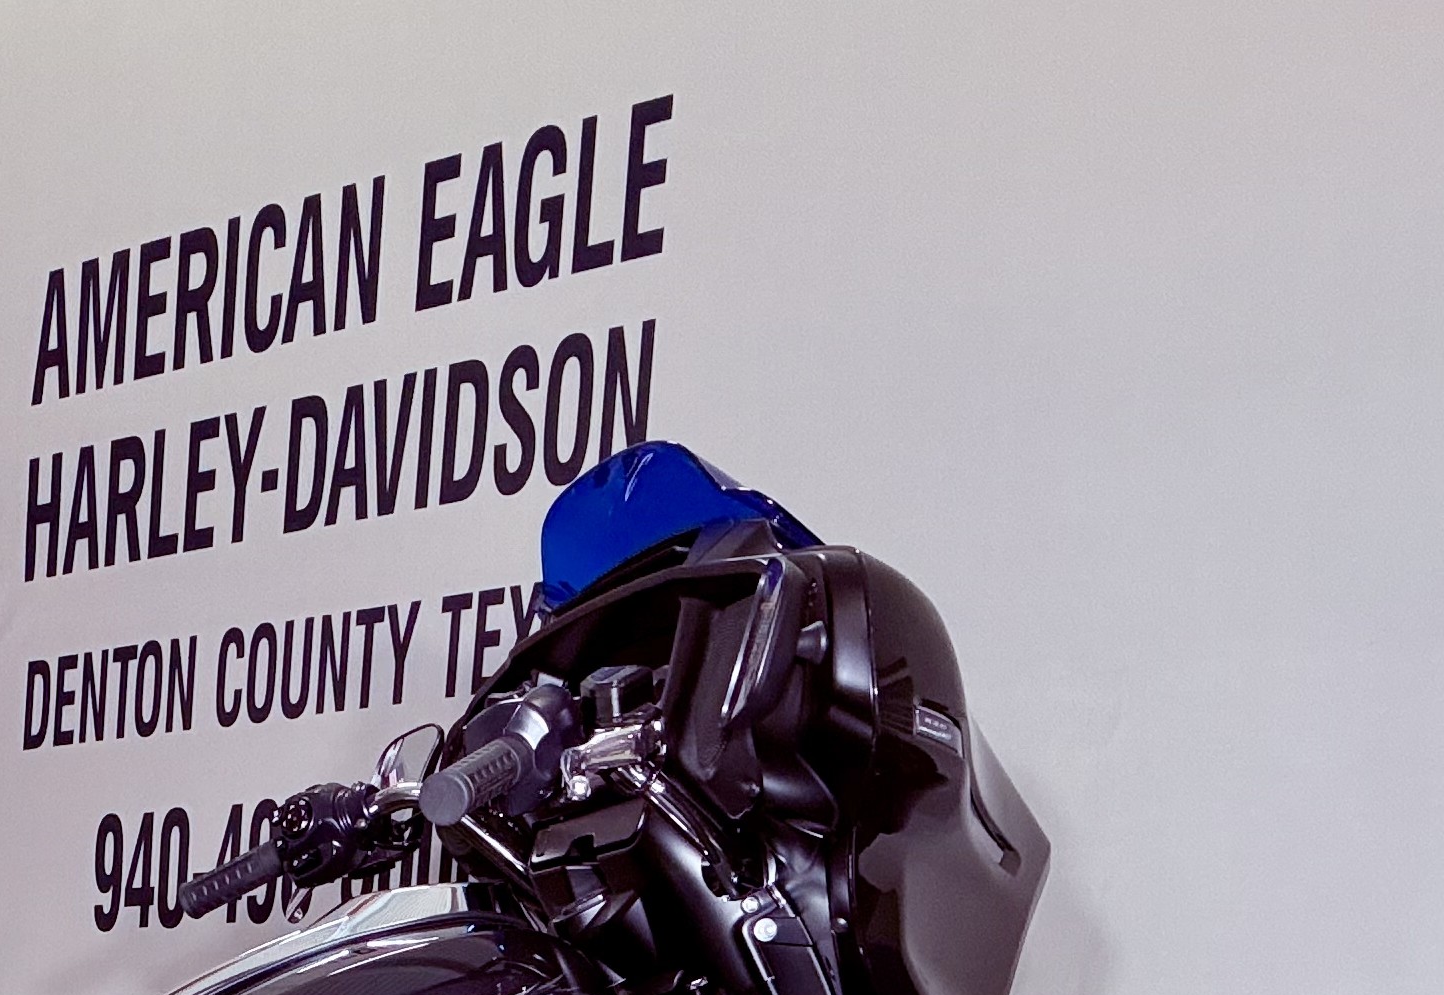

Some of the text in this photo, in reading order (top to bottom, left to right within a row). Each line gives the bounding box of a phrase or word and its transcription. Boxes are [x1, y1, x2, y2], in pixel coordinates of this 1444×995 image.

[30, 93, 674, 406] AMERICAN EAGLE
[24, 318, 657, 583] HARLEY-DAVIDSON
[22, 635, 197, 751] DENTON
[216, 600, 422, 728] COUNTY
